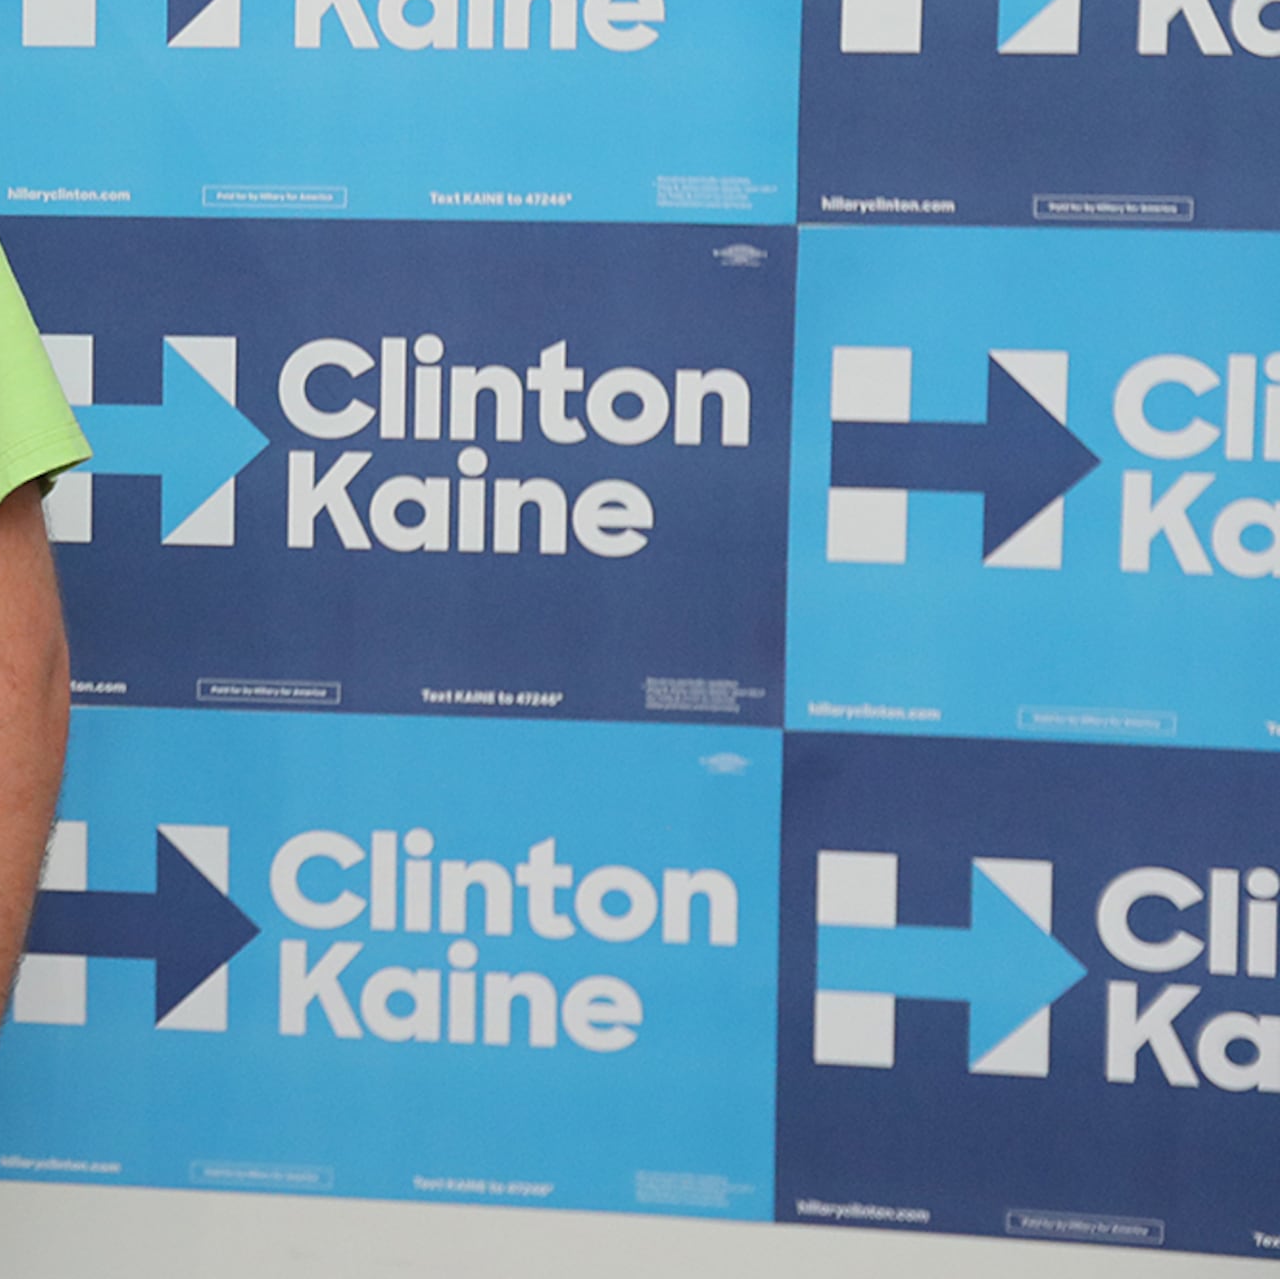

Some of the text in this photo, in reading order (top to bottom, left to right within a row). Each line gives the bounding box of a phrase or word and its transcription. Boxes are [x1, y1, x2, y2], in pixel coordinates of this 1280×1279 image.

[428, 191, 462, 205] Text
[462, 192, 504, 205] KAINE
[506, 192, 523, 205] to
[279, 335, 749, 445] Clinton
[288, 447, 653, 556] Kaine
[271, 829, 737, 945] Clinton
[280, 940, 642, 1051] Kaine
[1251, 1232, 1280, 1247] Tex
